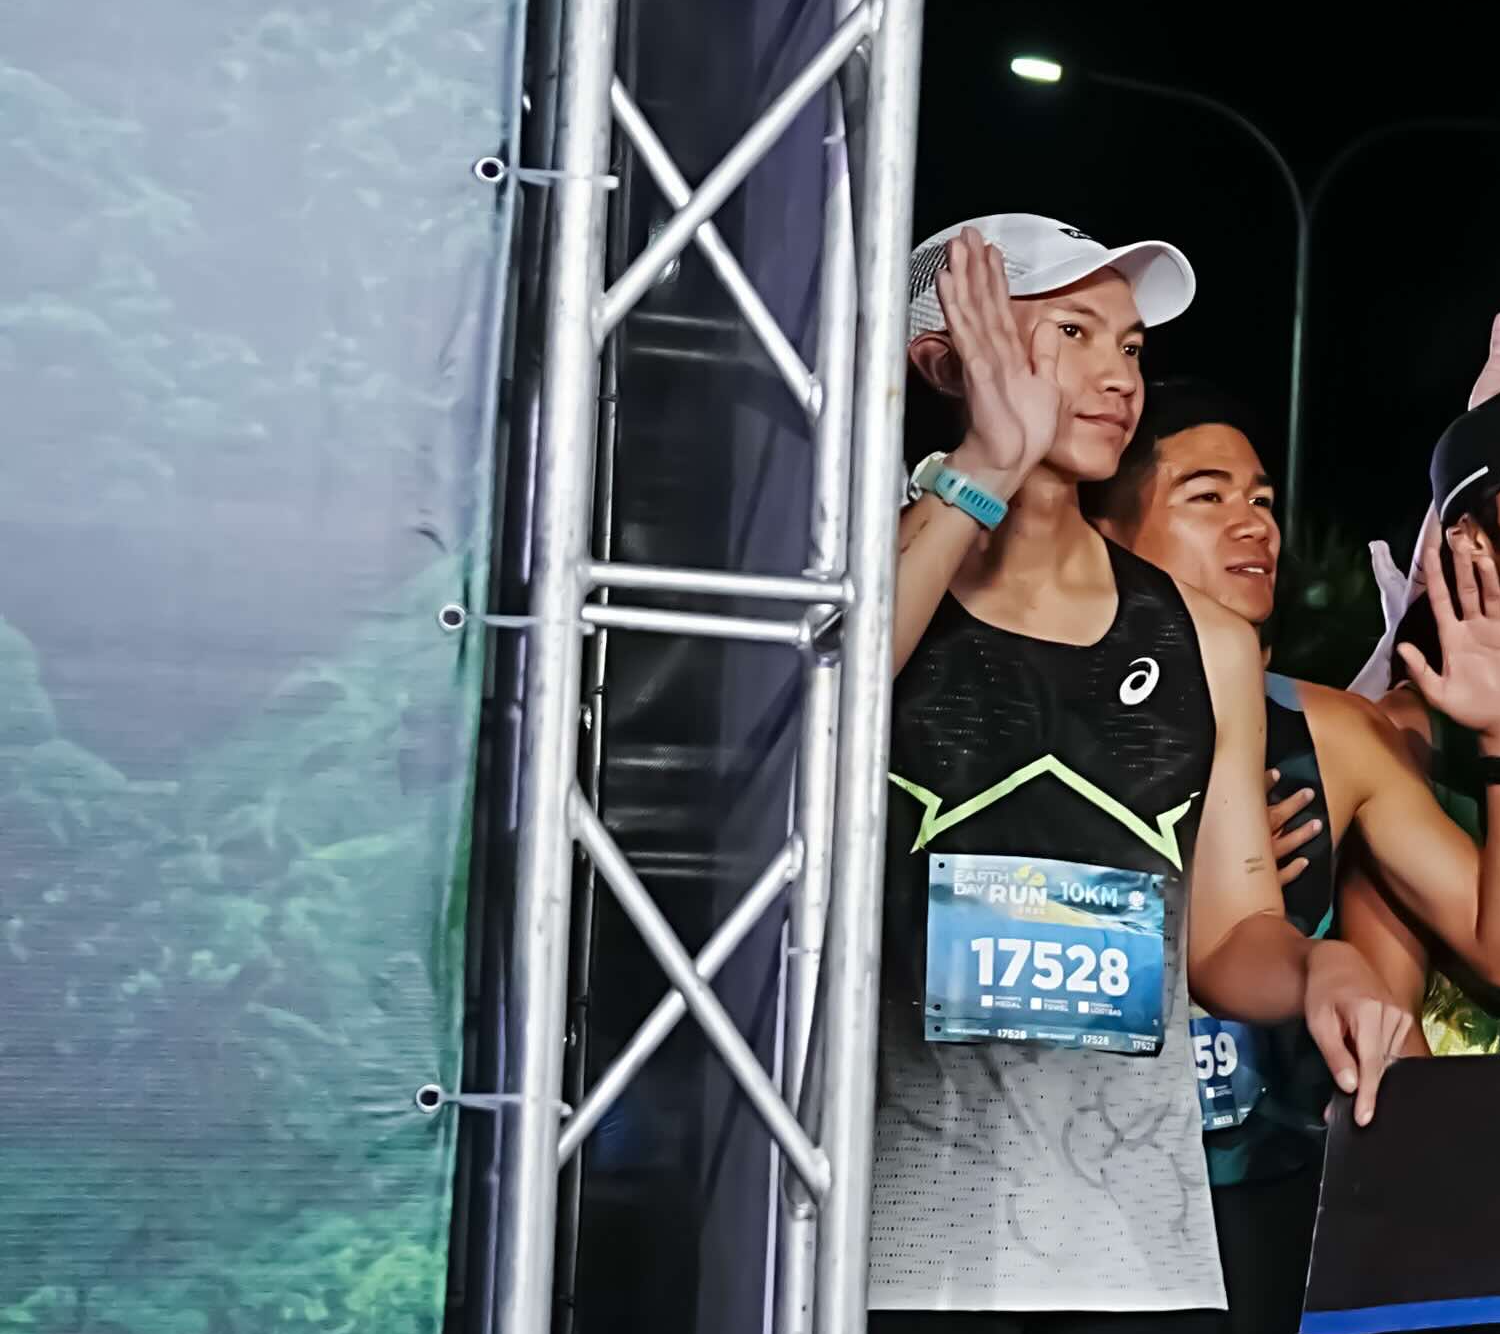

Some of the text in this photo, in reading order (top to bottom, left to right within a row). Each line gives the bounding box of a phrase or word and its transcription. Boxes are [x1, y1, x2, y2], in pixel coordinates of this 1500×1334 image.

[953, 868, 1009, 884] EARTH
[953, 881, 1119, 908] DAY RUN 10KM
[971, 937, 1130, 997] 17528
